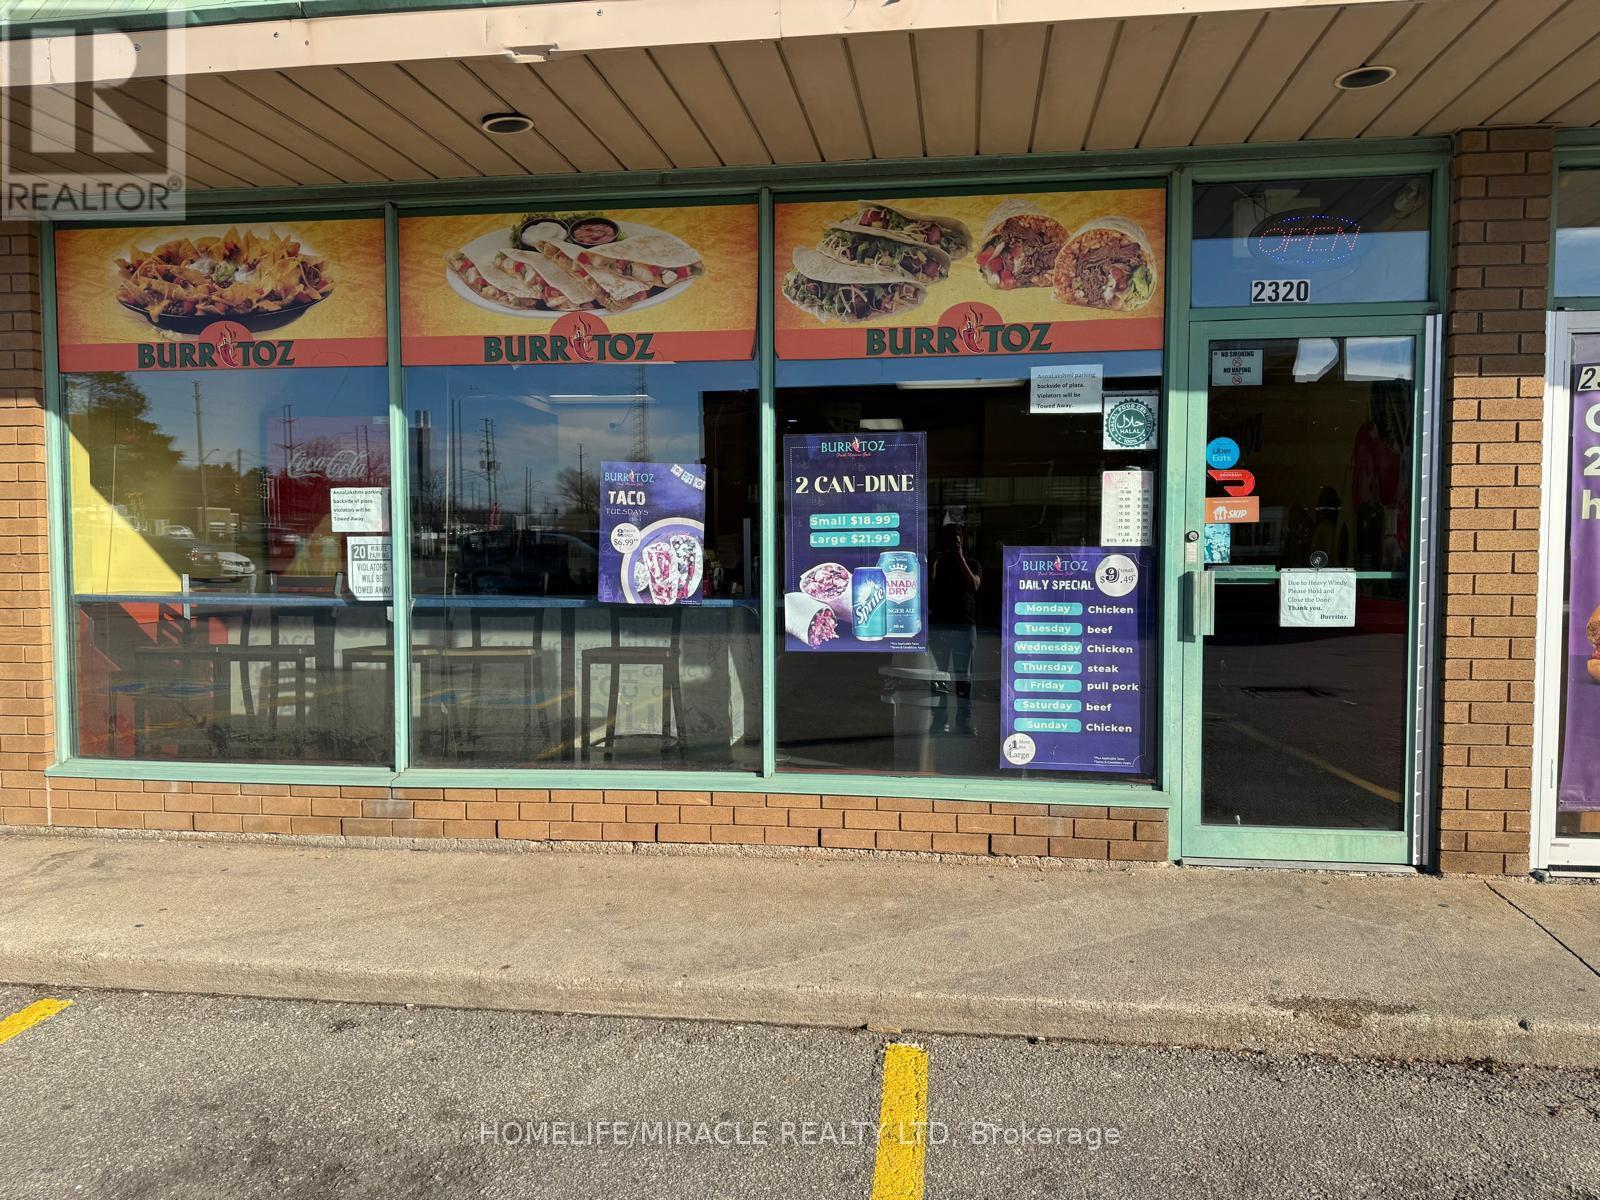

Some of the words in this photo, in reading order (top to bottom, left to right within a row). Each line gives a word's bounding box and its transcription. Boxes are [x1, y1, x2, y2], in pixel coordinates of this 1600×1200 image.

[1259, 225, 1361, 254] OPEN
[1253, 280, 1309, 302] 2320
[1075, 372, 1096, 380] parking
[1117, 414, 1145, 429] حلال
[287, 447, 368, 478] Coca-Cola
[795, 476, 809, 493] 2
[814, 474, 914, 493] CAN-DINE
[608, 490, 646, 506] TACO
[606, 508, 649, 516] TUESDAYS
[1227, 509, 1248, 519] SKIP
[810, 515, 846, 526] Small
[810, 535, 846, 545] Large
[353, 545, 366, 559] 20
[356, 563, 388, 572] VIOLATORS
[361, 575, 375, 583] WILL
[376, 575, 384, 583] BE
[355, 586, 374, 594] TOWED
[375, 586, 391, 594] AWAY
[886, 580, 916, 590] ANADA
[1019, 579, 1049, 591] DAILY
[1051, 579, 1094, 591] SPECIAL
[856, 587, 884, 625] Sprite
[1026, 604, 1071, 614] Monday
[1087, 605, 1134, 614] Chicken
[1025, 624, 1072, 634] Tuesday
[1087, 625, 1113, 634] beef
[1016, 642, 1081, 653] Wednesday
[1087, 644, 1133, 654] Chicken
[1022, 662, 1074, 673] Thursday
[1087, 664, 1119, 673] steak
[1030, 681, 1065, 691] Friday
[1087, 682, 1109, 691] pull
[1112, 682, 1140, 692] pork
[1023, 700, 1073, 711] Saturday
[1086, 703, 1112, 712] beef
[1026, 720, 1069, 730] Sunday
[1086, 723, 1133, 733] Chicken
[1009, 751, 1030, 760] Large
